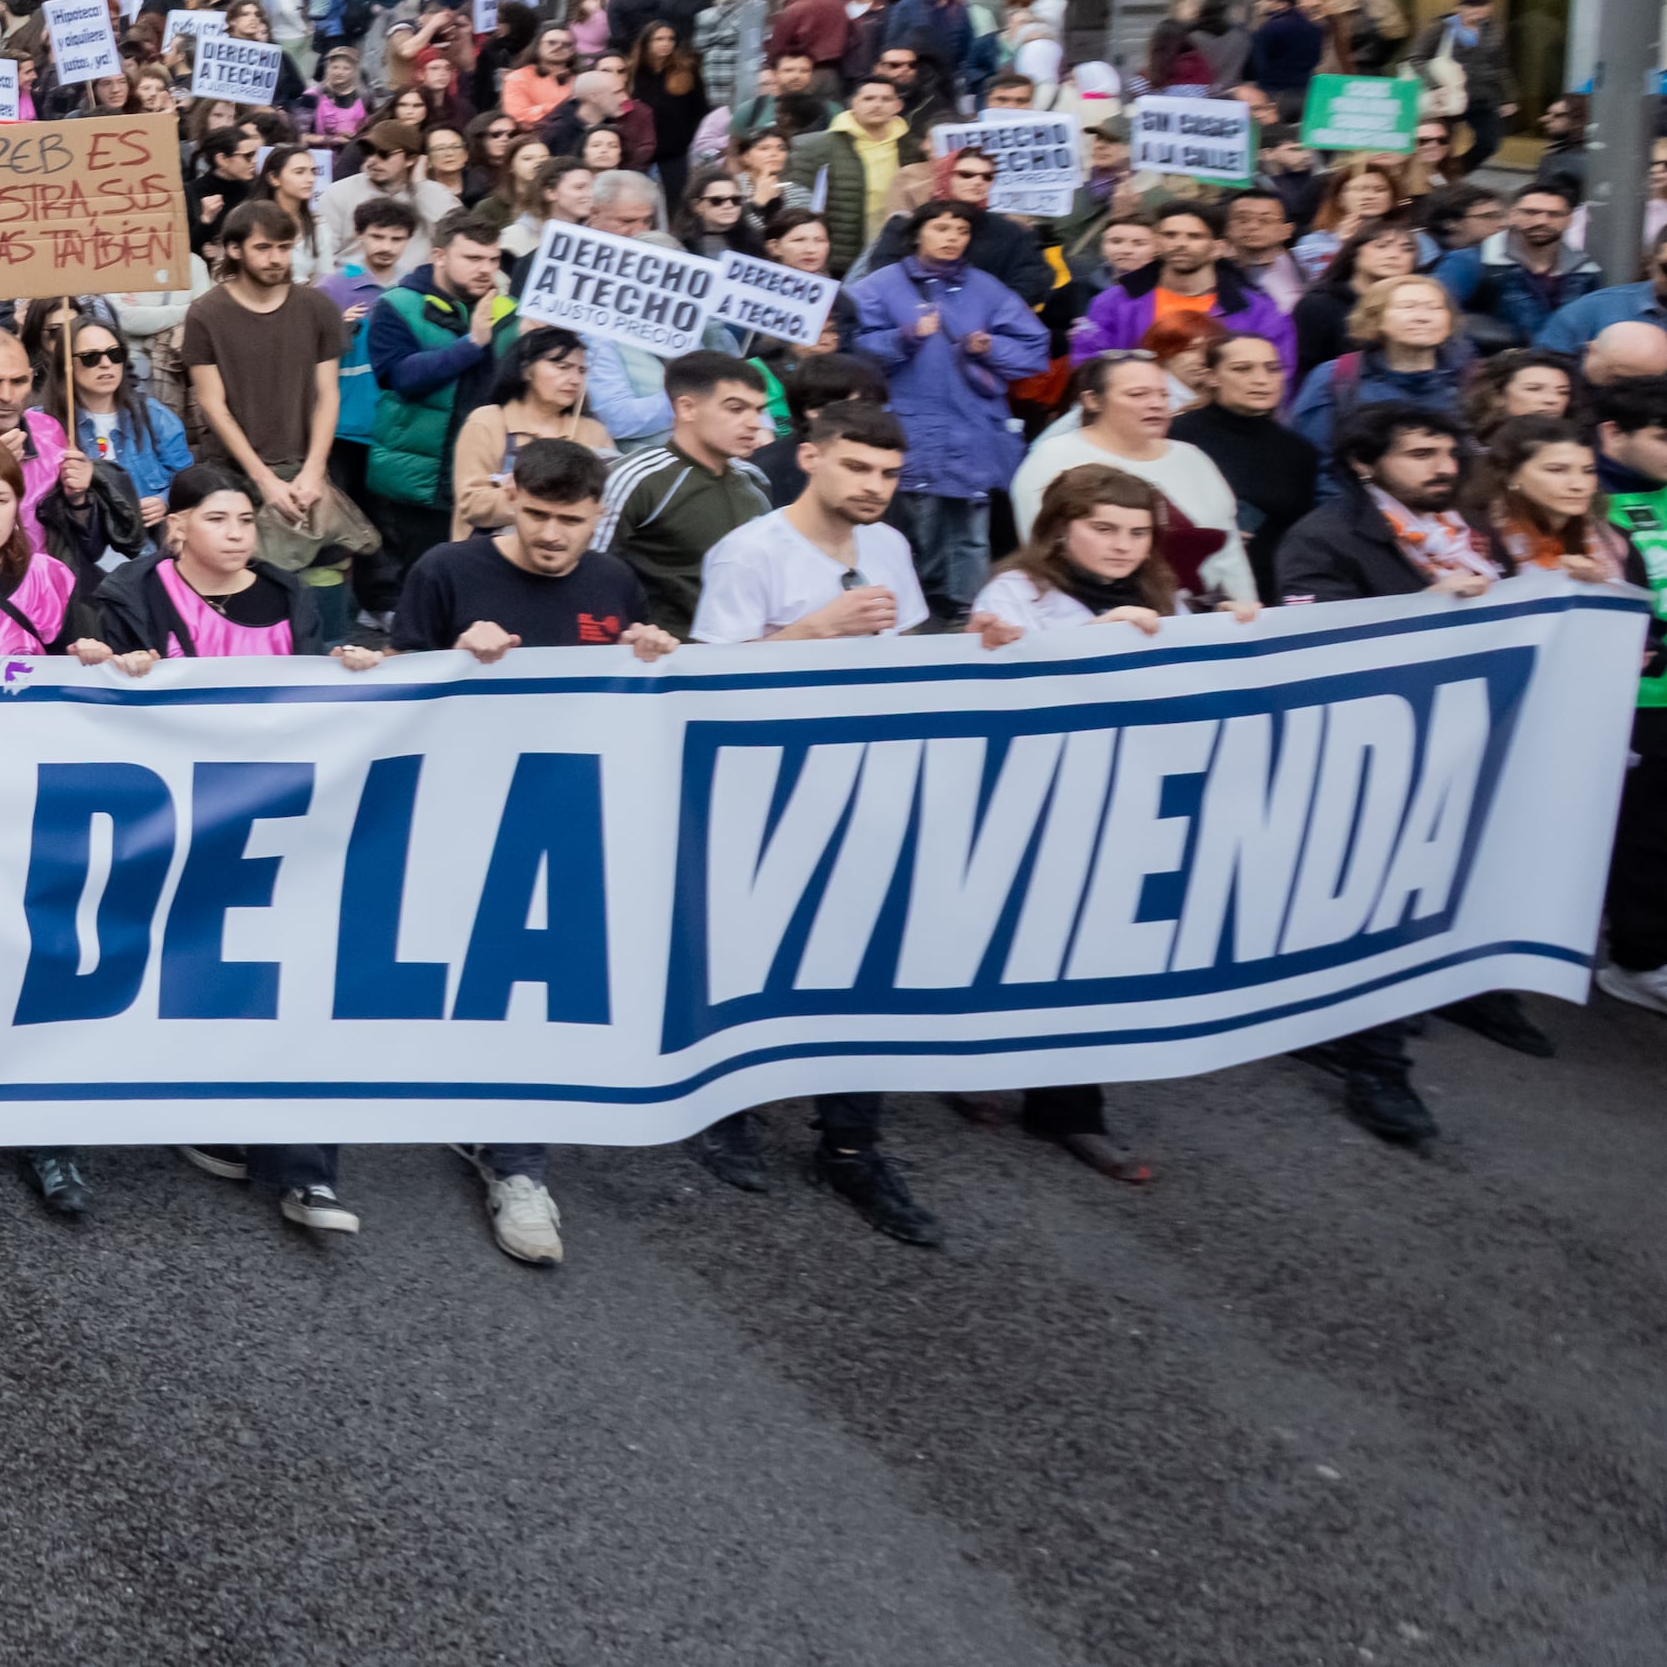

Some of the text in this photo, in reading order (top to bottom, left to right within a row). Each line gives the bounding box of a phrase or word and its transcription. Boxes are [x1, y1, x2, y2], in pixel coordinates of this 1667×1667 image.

[199, 63, 275, 89] A TECHO
[203, 42, 280, 69] DERECHO
[85, 129, 152, 170] ES
[98, 173, 172, 216] SUS
[547, 232, 714, 300] DERECHO
[727, 260, 825, 305] DERECHO
[534, 265, 699, 333] A TECHO
[716, 294, 810, 340] A TECHO.
[528, 295, 694, 349] A JUSTO PRECIO!
[13, 762, 314, 1026] DE
[332, 753, 611, 1025] LA
[708, 676, 1491, 1007] VIVIENDA
